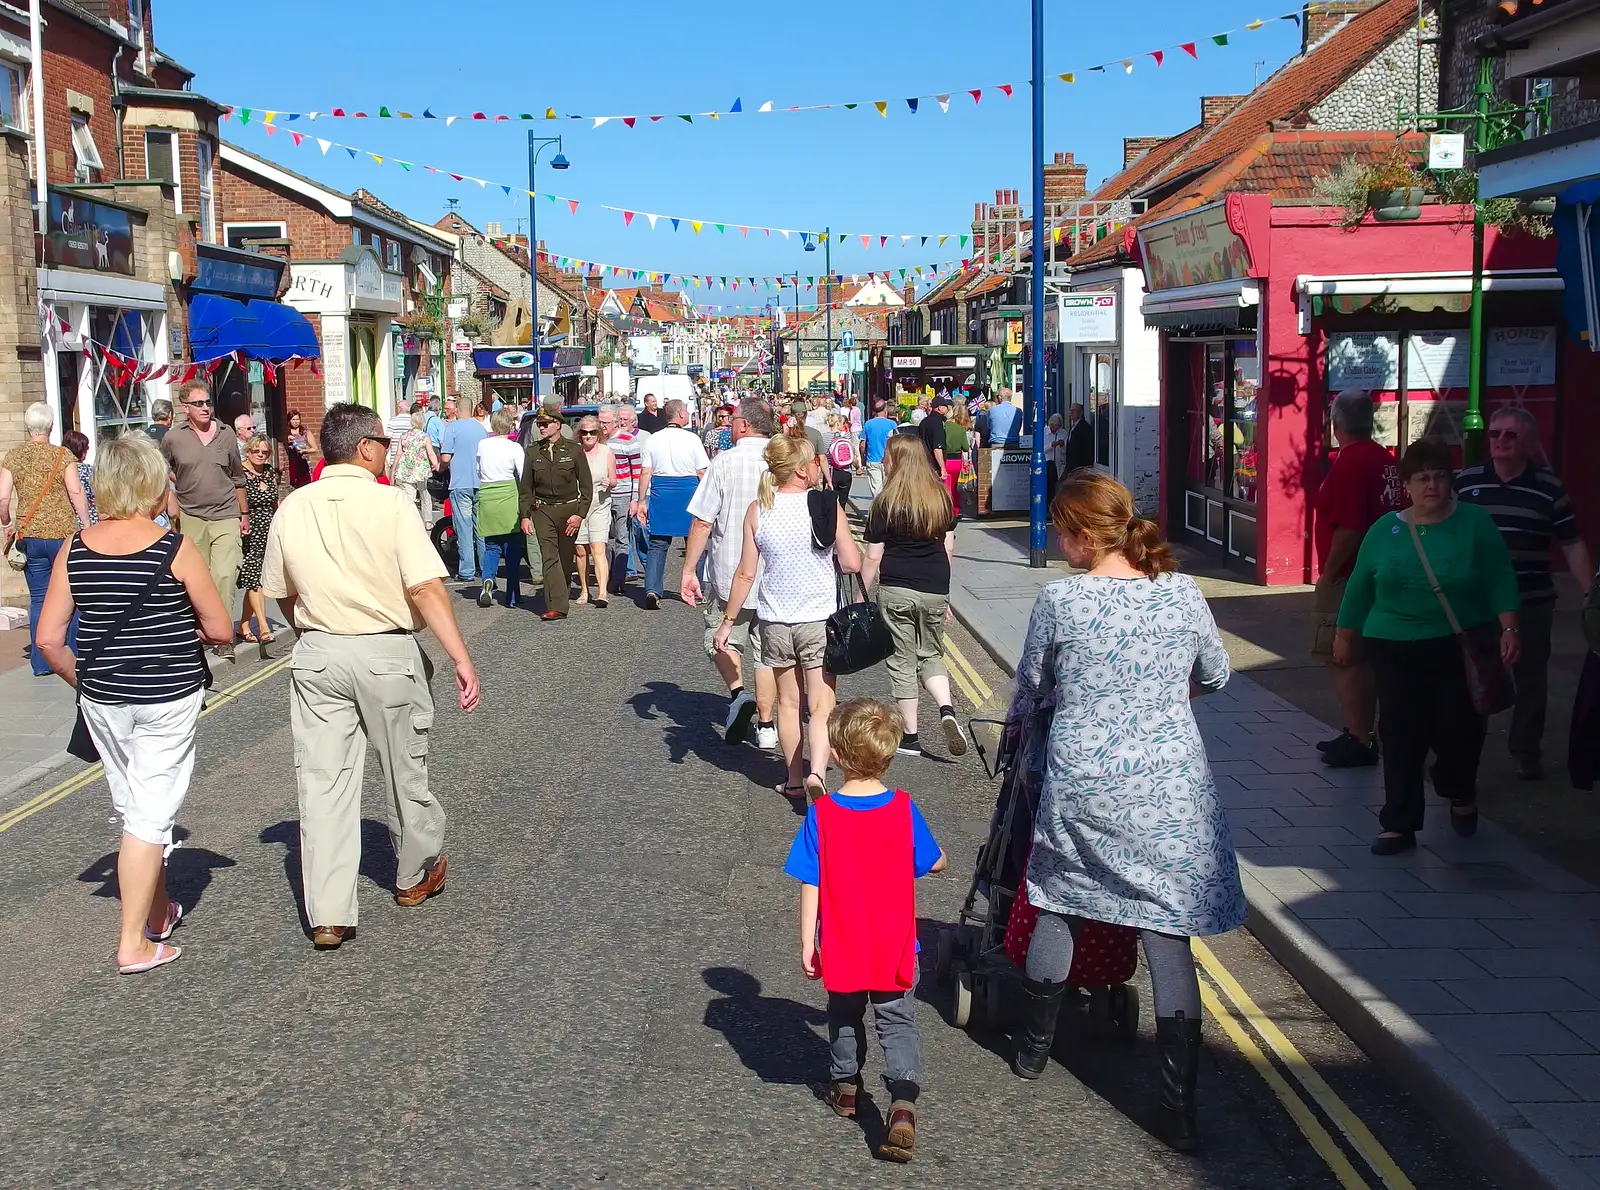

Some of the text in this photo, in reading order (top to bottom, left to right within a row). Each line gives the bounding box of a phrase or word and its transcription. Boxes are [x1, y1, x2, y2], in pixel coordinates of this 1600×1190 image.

[295, 275, 333, 299] RTH
[1495, 328, 1549, 342] HONEY
[1000, 454, 1032, 463] BROWN
